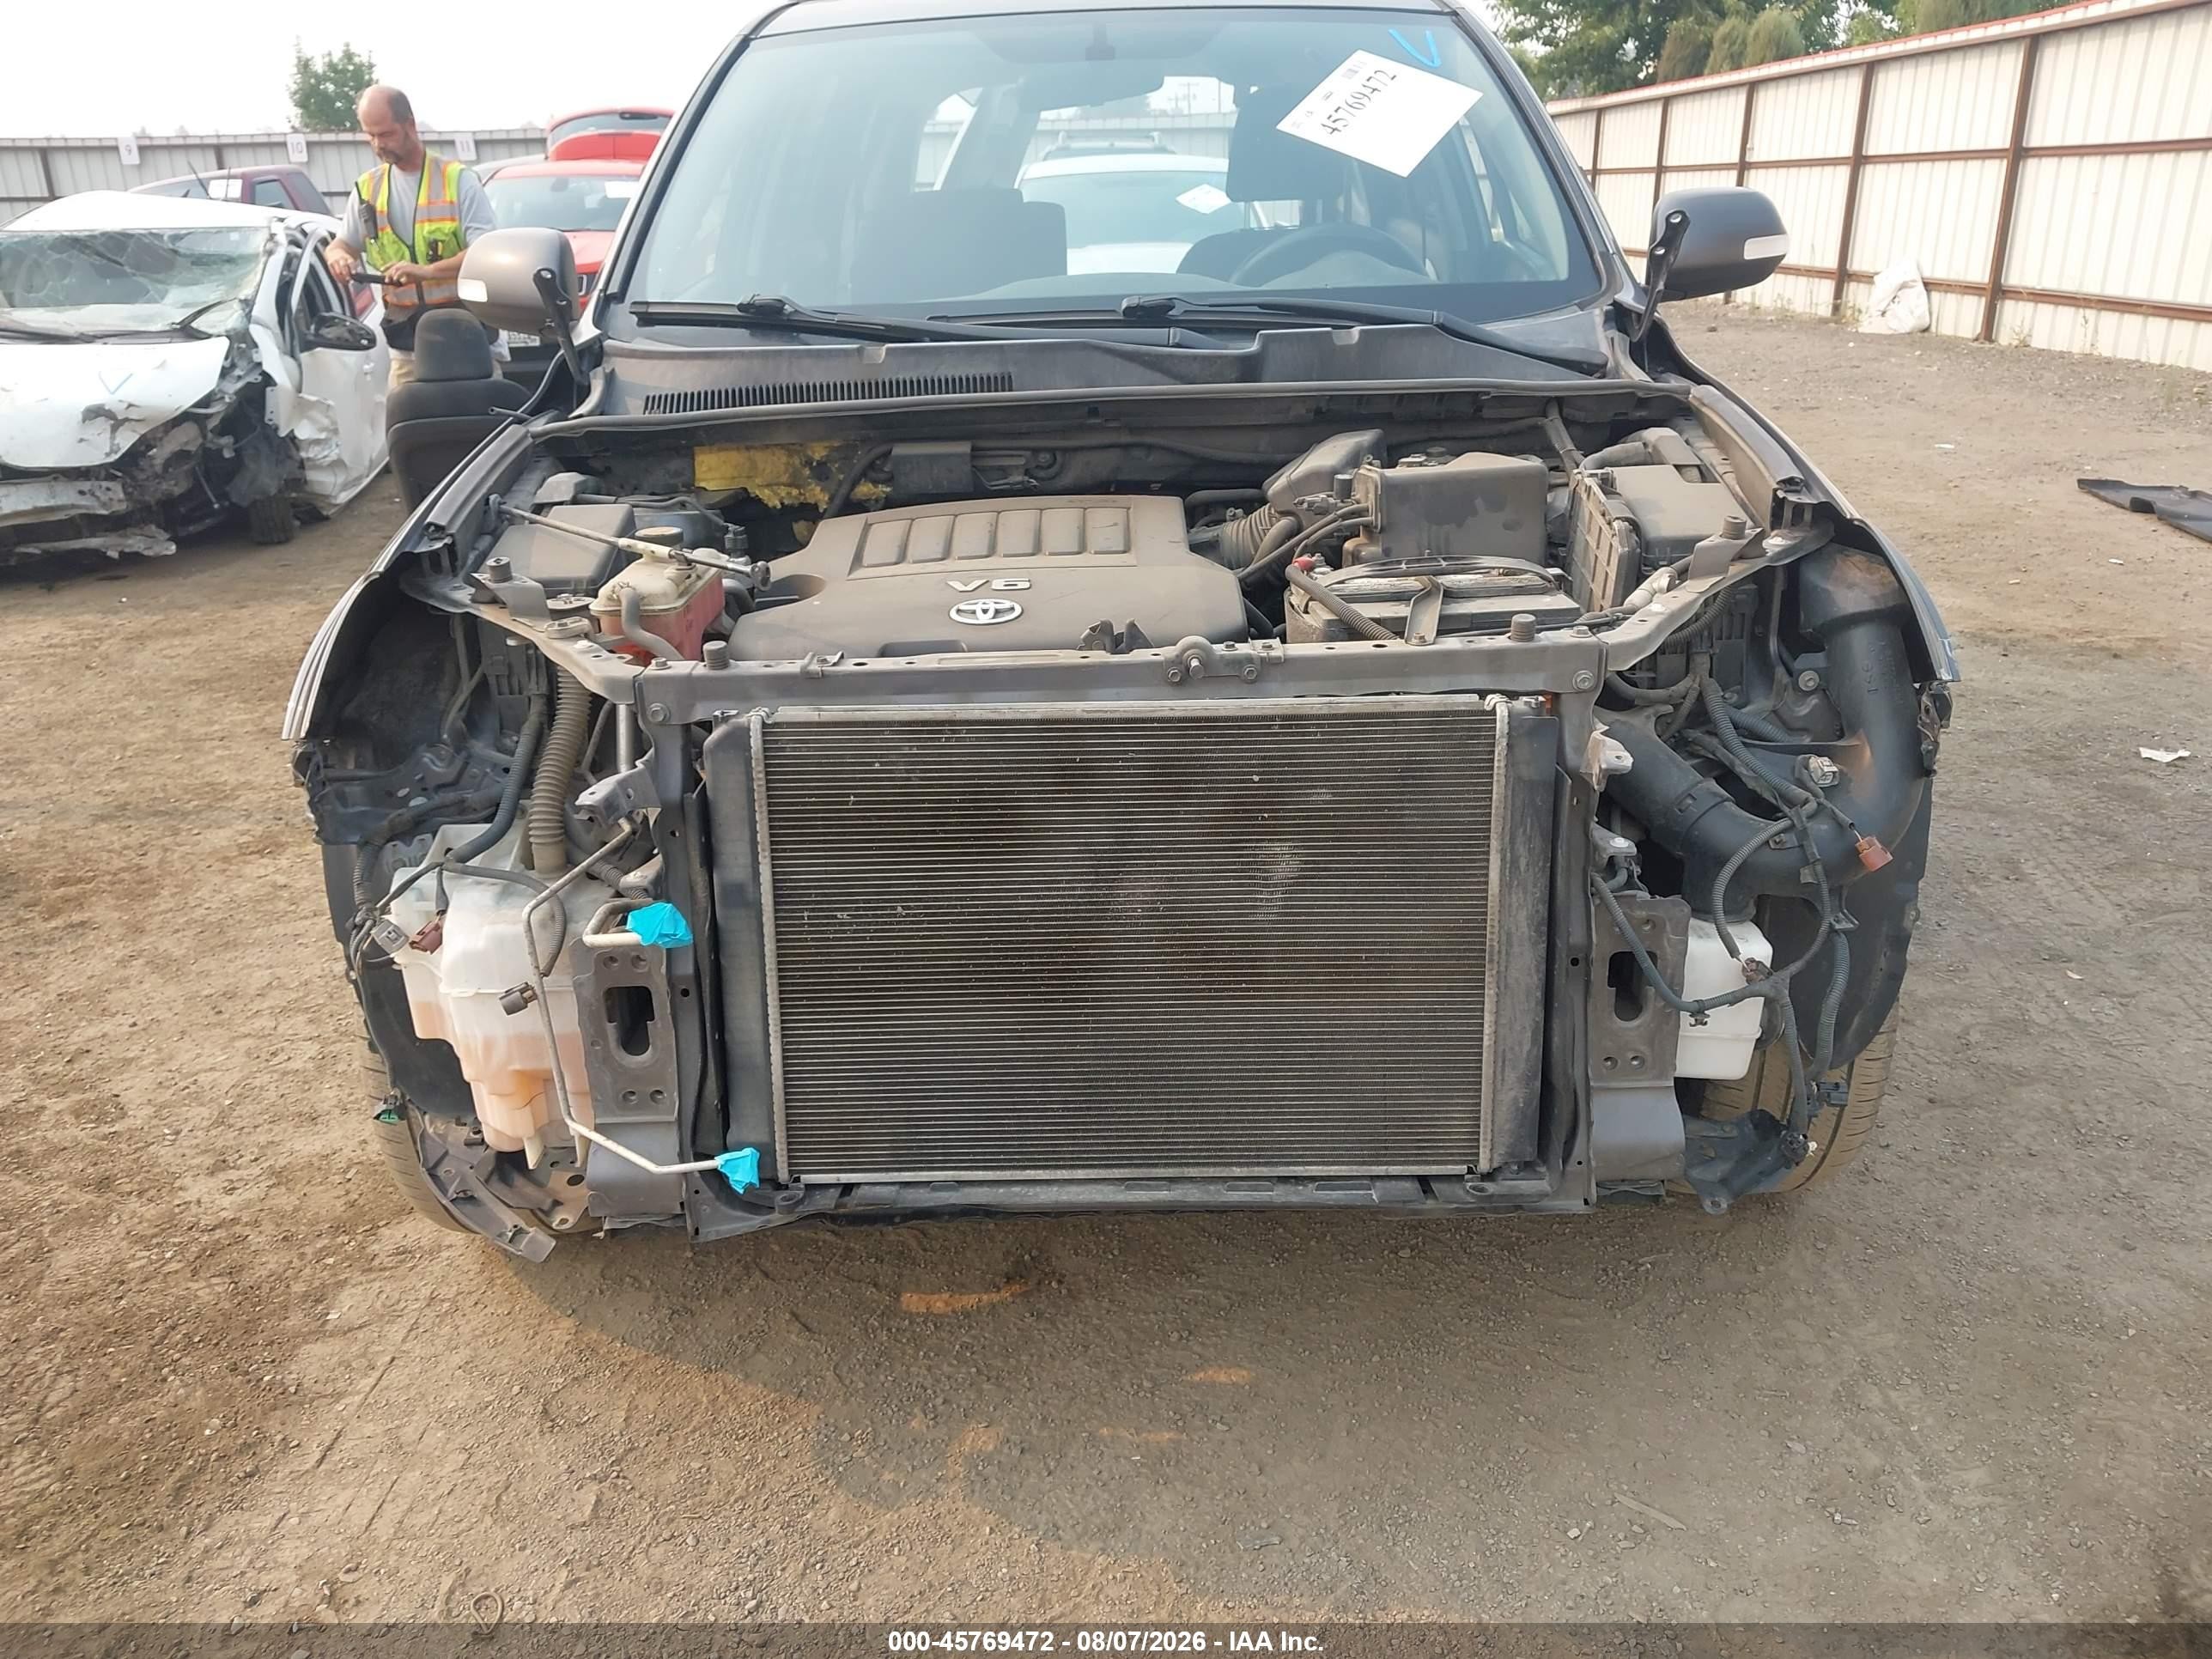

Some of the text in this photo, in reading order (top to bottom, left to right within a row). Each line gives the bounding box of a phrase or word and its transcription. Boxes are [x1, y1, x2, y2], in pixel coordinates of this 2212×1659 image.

[1321, 70, 1397, 136] 45769472
[125, 143, 132, 156] 9
[290, 141, 303, 155] 10
[946, 578, 1031, 592] V6
